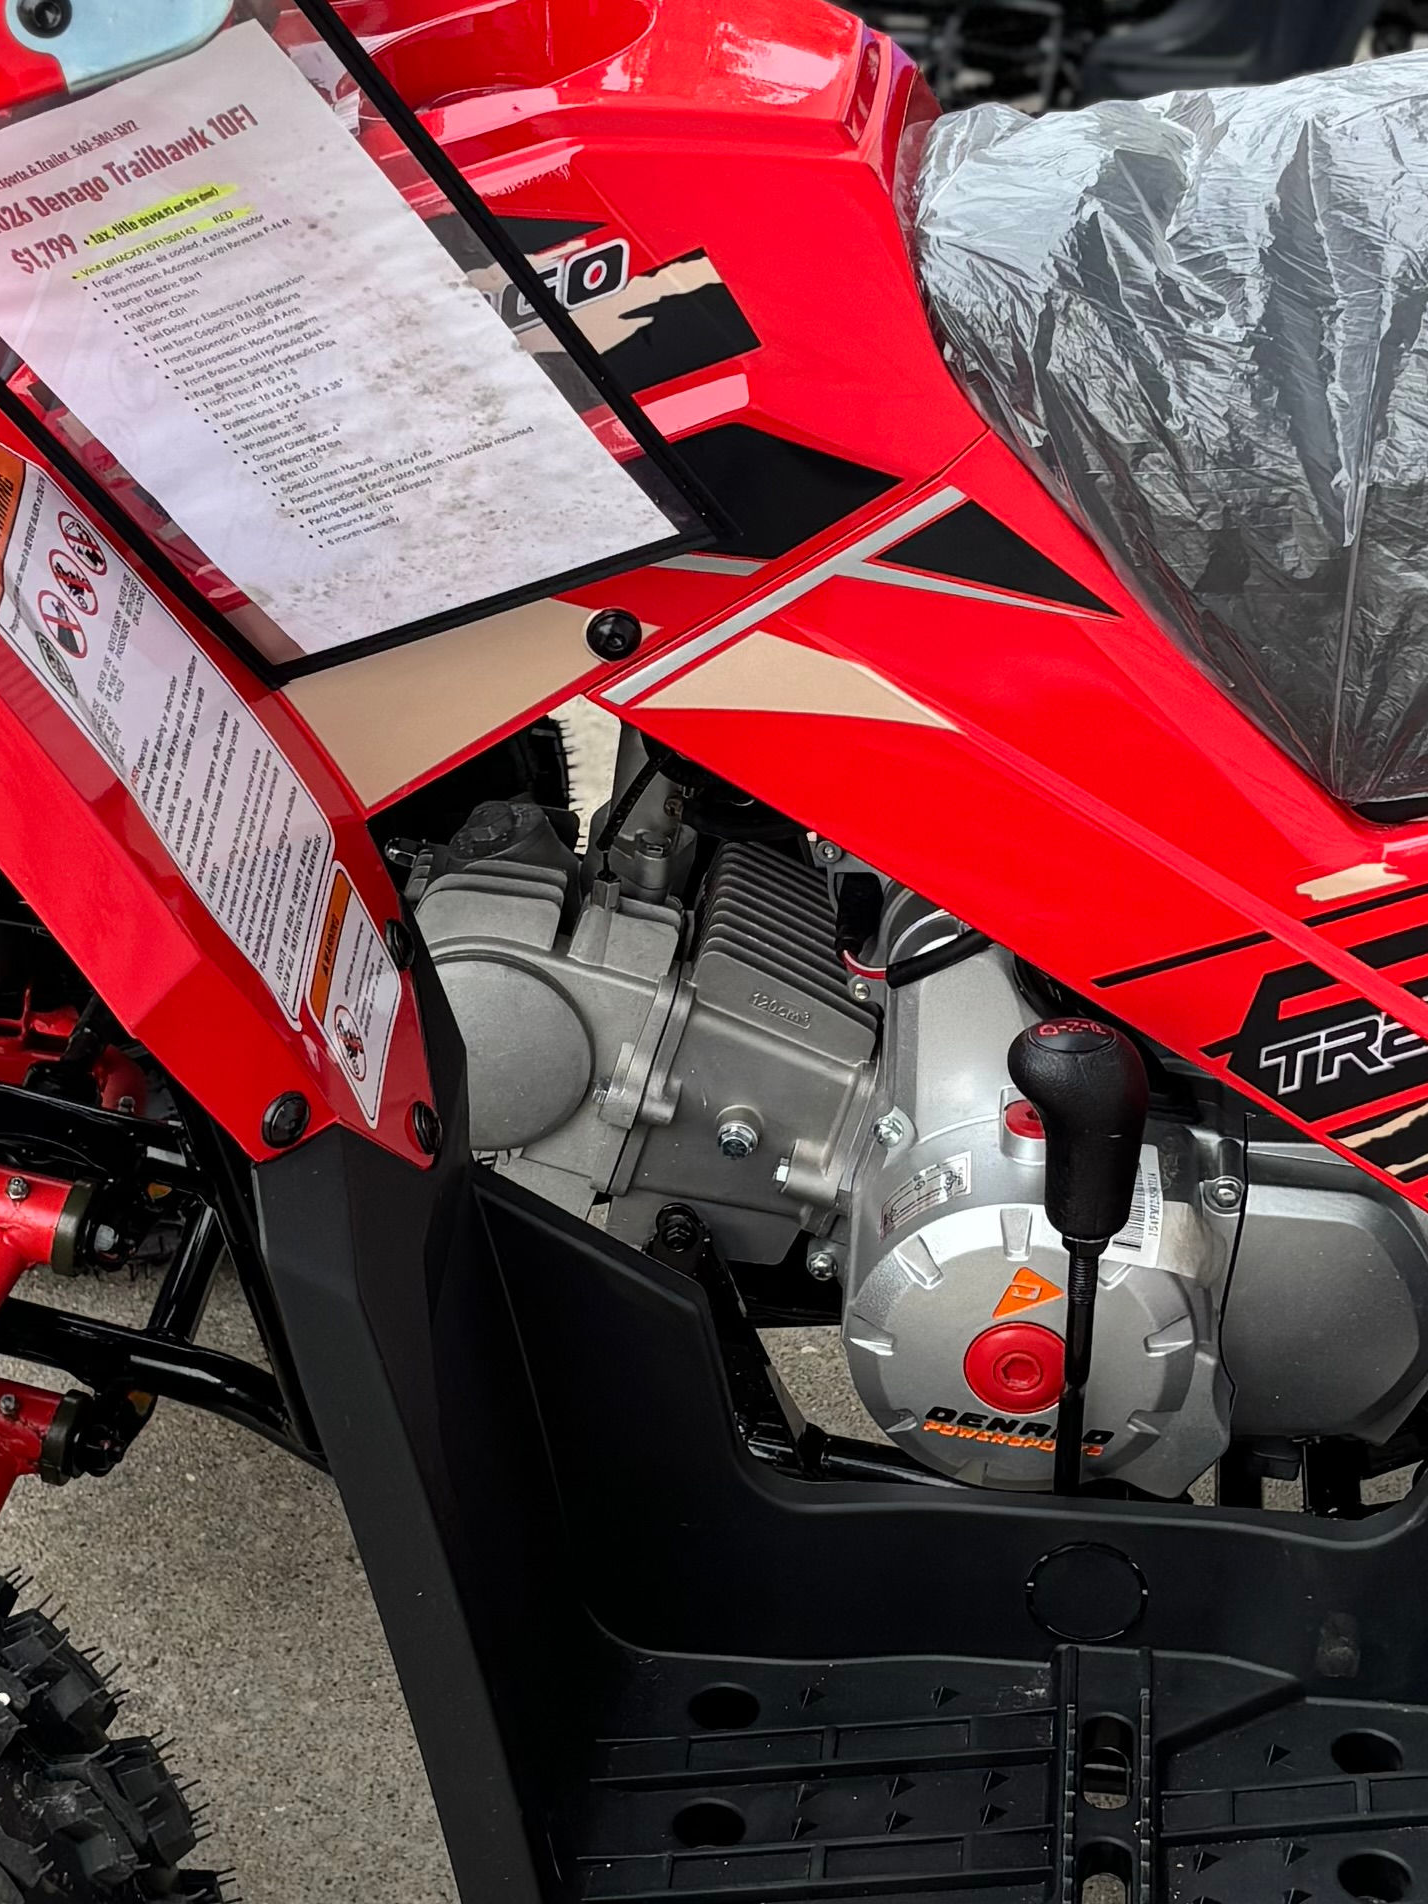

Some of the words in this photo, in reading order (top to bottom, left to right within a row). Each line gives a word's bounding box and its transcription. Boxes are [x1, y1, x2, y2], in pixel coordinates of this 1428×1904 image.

[26, 176, 108, 216] Denago
[103, 128, 213, 184] Trailhawk
[206, 104, 257, 138] 10FI
[26, 164, 41, 176] &
[34, 151, 71, 171] Trailer
[211, 210, 233, 223] RED
[237, 214, 264, 230] motor
[11, 233, 77, 273] $1,799
[88, 230, 116, 244] tax,
[111, 220, 138, 235] title
[101, 272, 161, 298] Transmission:
[162, 254, 208, 275] Automatic
[225, 230, 263, 249] Reverse
[143, 281, 179, 297] Electric
[178, 271, 202, 284] Start
[122, 307, 146, 321] Final
[170, 288, 199, 302] Chain
[142, 330, 164, 343] Fuel
[200, 299, 247, 321] Electronic
[245, 290, 267, 302] Fuel
[265, 274, 305, 294] Injection
[168, 306, 187, 318] CDI
[152, 342, 173, 354] Fuel
[171, 335, 194, 346] Tank
[250, 304, 266, 315] US
[264, 292, 300, 309] Gallons
[163, 352, 188, 365] Front
[240, 318, 274, 335] Double
[281, 307, 301, 318] Arm
[172, 364, 194, 375] Rear
[247, 333, 274, 347] Mono
[272, 316, 318, 337] Swingarm
[182, 373, 207, 387] Front
[238, 352, 262, 365] Dual
[259, 336, 303, 357] Hydraulic
[192, 386, 214, 398] Rear
[246, 363, 274, 377] Single
[273, 347, 316, 366] Hydraulic
[202, 394, 228, 408] Front
[251, 380, 262, 390] AT
[211, 407, 233, 419] Rear
[231, 428, 254, 441] Seat
[251, 445, 285, 461] Ground
[260, 463, 278, 472] Dry
[299, 460, 318, 472] LED
[280, 478, 309, 494] Speed
[339, 455, 374, 471] Manual
[289, 488, 323, 504] Remote
[395, 456, 414, 466] Key
[307, 510, 342, 525] Parking
[366, 490, 392, 503] Hand
[391, 476, 432, 494] Activated
[324, 490, 358, 505] Ignition
[317, 518, 358, 536] Minimum
[334, 529, 363, 542] month
[362, 516, 399, 532] warranty
[922, 1420, 1104, 1457] POWERSPOS
[924, 1405, 1115, 1445] DENAO
